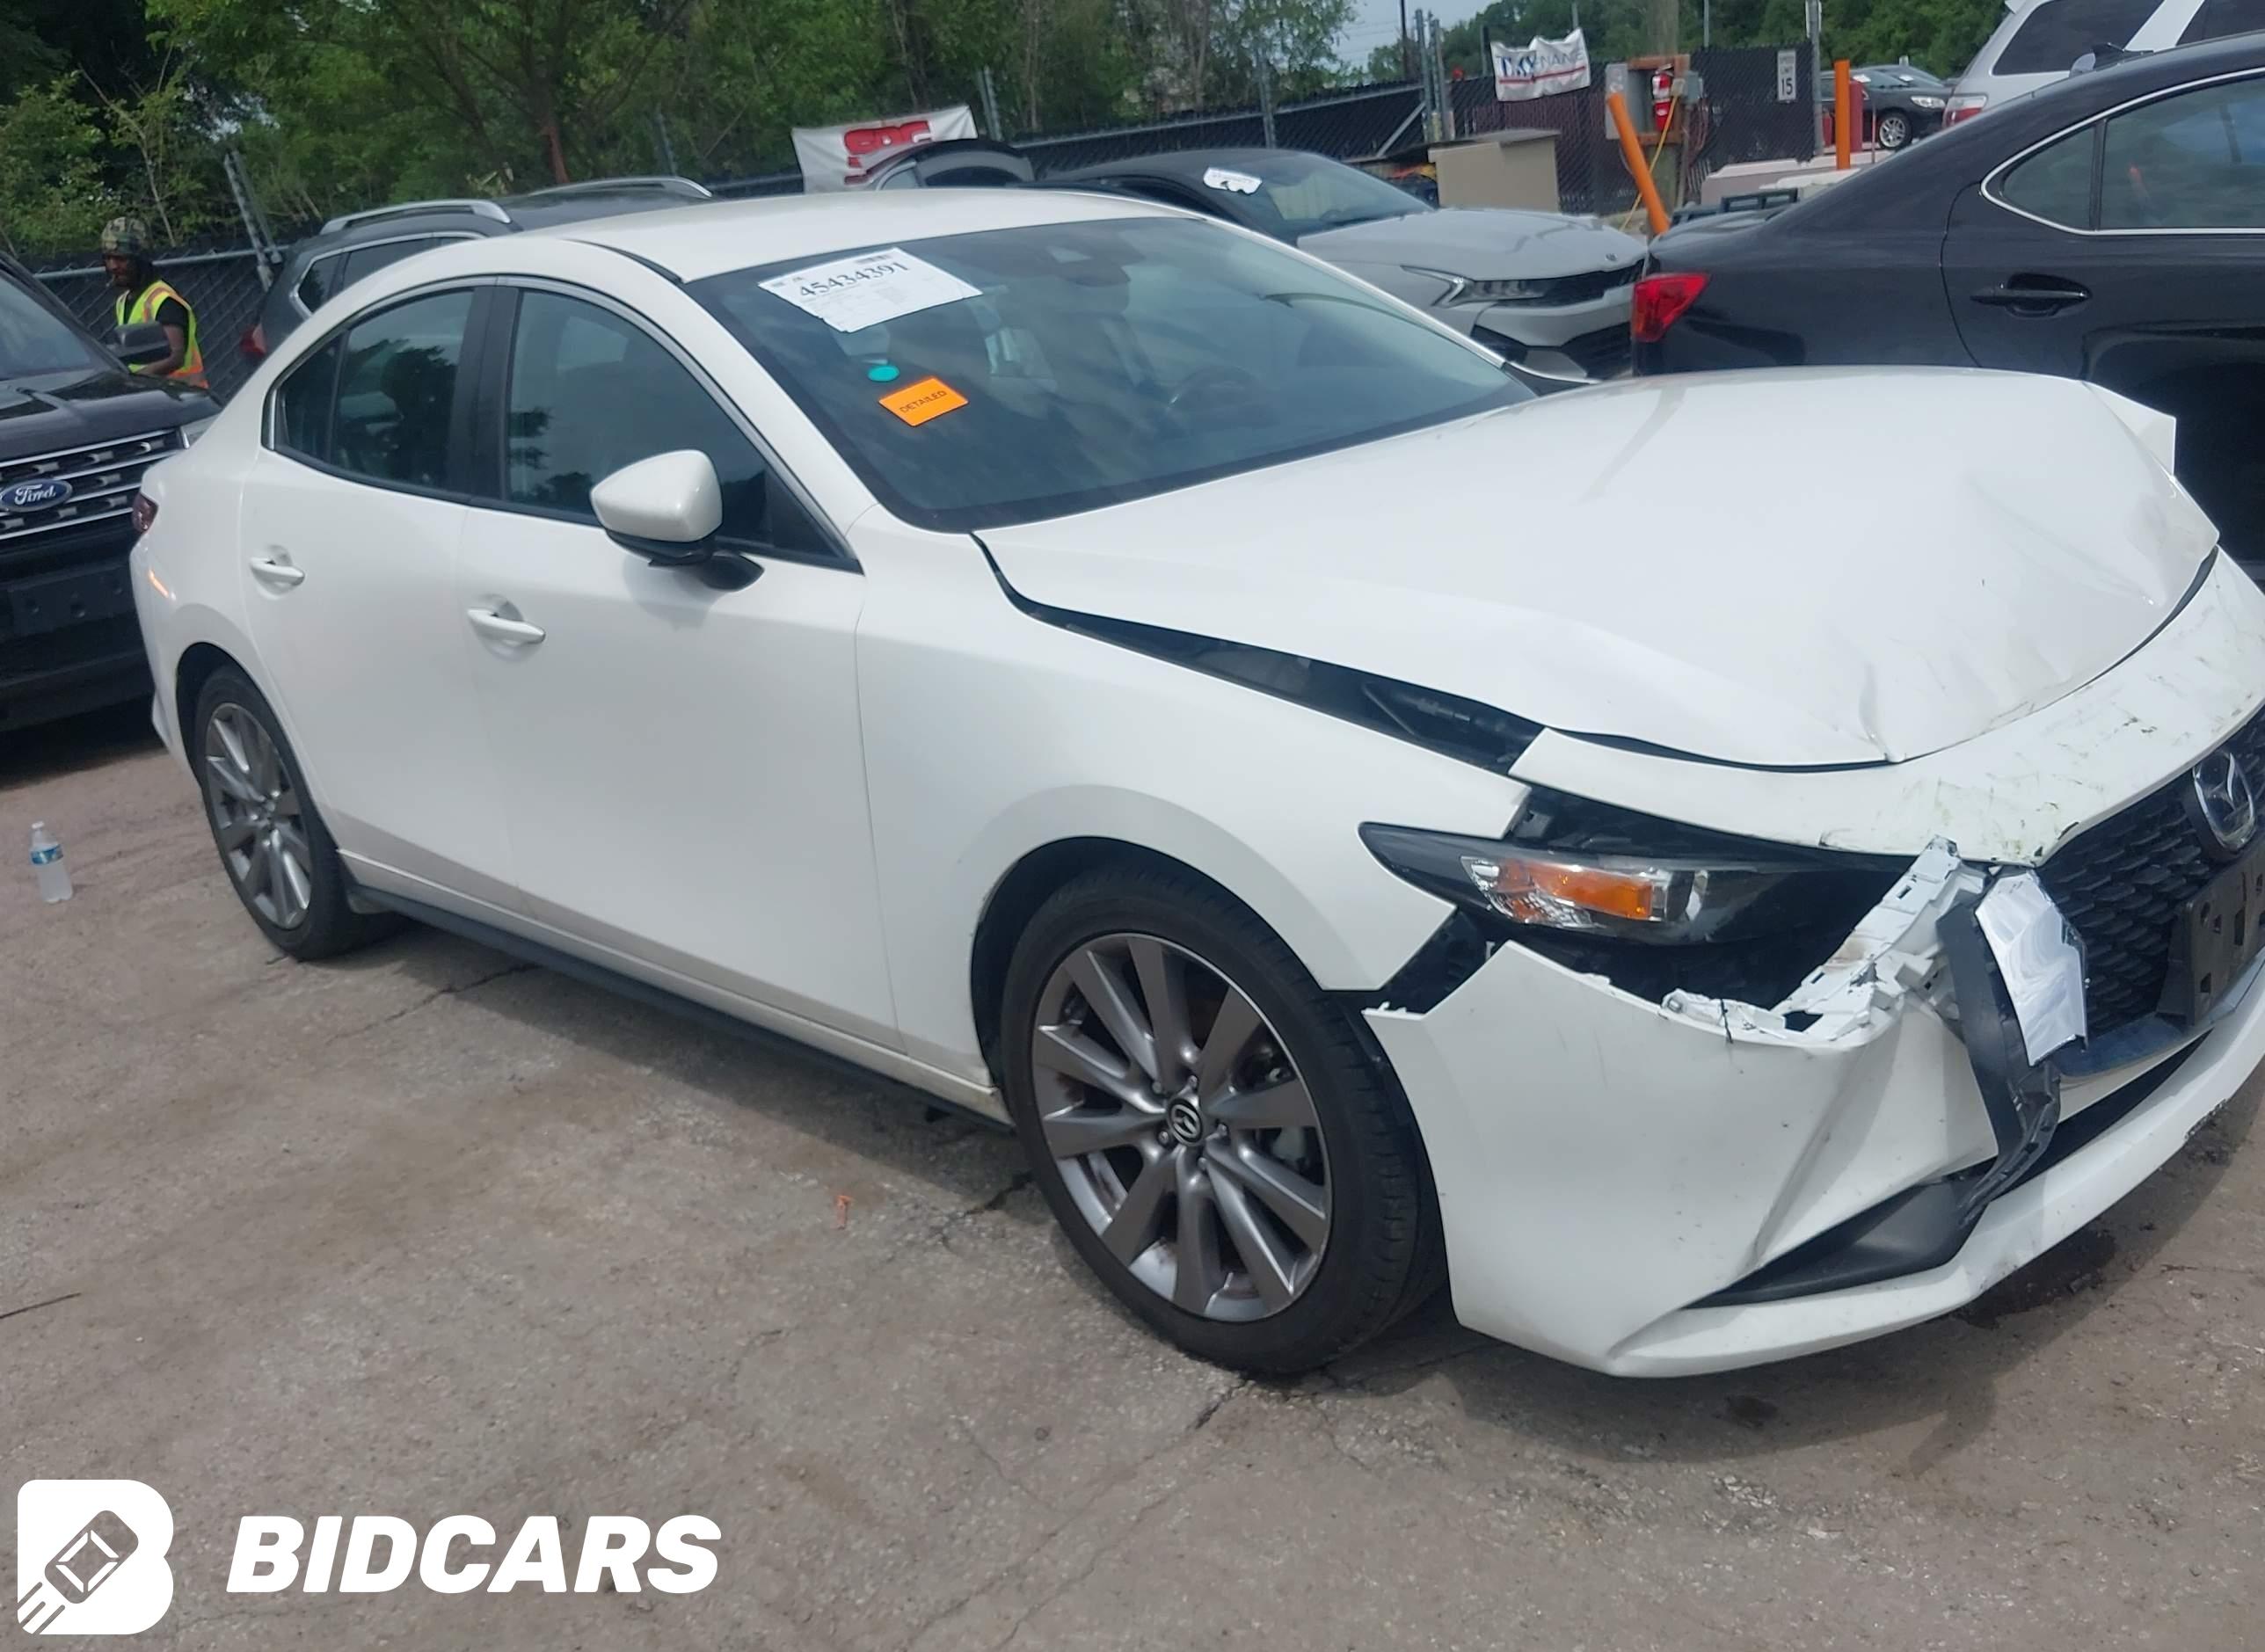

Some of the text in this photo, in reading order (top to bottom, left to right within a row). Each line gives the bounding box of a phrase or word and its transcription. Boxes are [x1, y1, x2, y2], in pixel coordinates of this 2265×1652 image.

[1781, 77, 1793, 96] 15
[800, 262, 908, 296] 45434391
[899, 390, 948, 414] DETAILED
[14, 484, 56, 506] Ford
